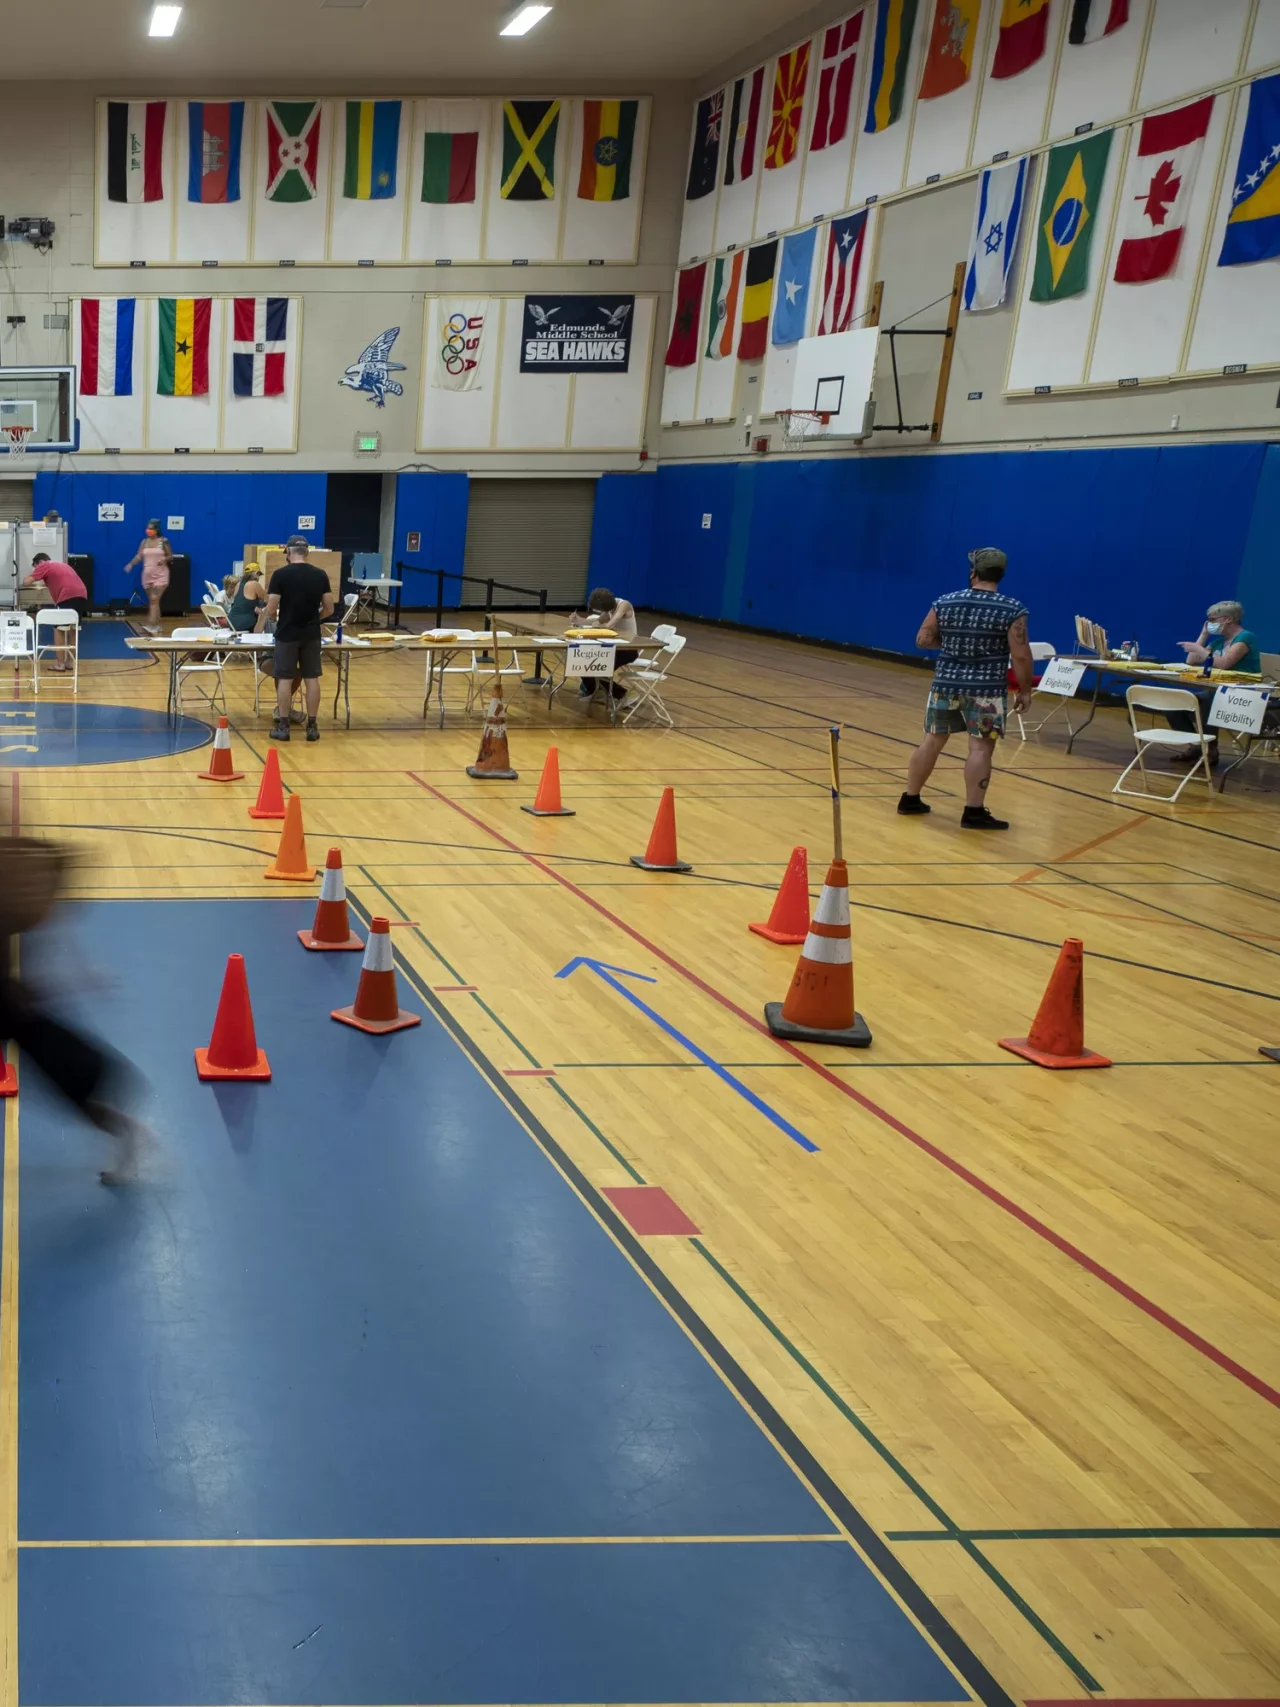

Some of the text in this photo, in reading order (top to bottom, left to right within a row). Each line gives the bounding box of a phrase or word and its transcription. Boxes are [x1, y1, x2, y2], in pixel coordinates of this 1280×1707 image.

[536, 331, 618, 339] Middle School
[525, 342, 626, 360] SEA HAWKS
[1225, 364, 1245, 373] BOSNIA
[1120, 378, 1137, 386] CANADA
[573, 649, 610, 660] Register
[1057, 664, 1075, 674] Voter
[1045, 677, 1073, 690] Eligibility
[1228, 695, 1252, 707] Voter
[1216, 710, 1255, 728] Eligibility
